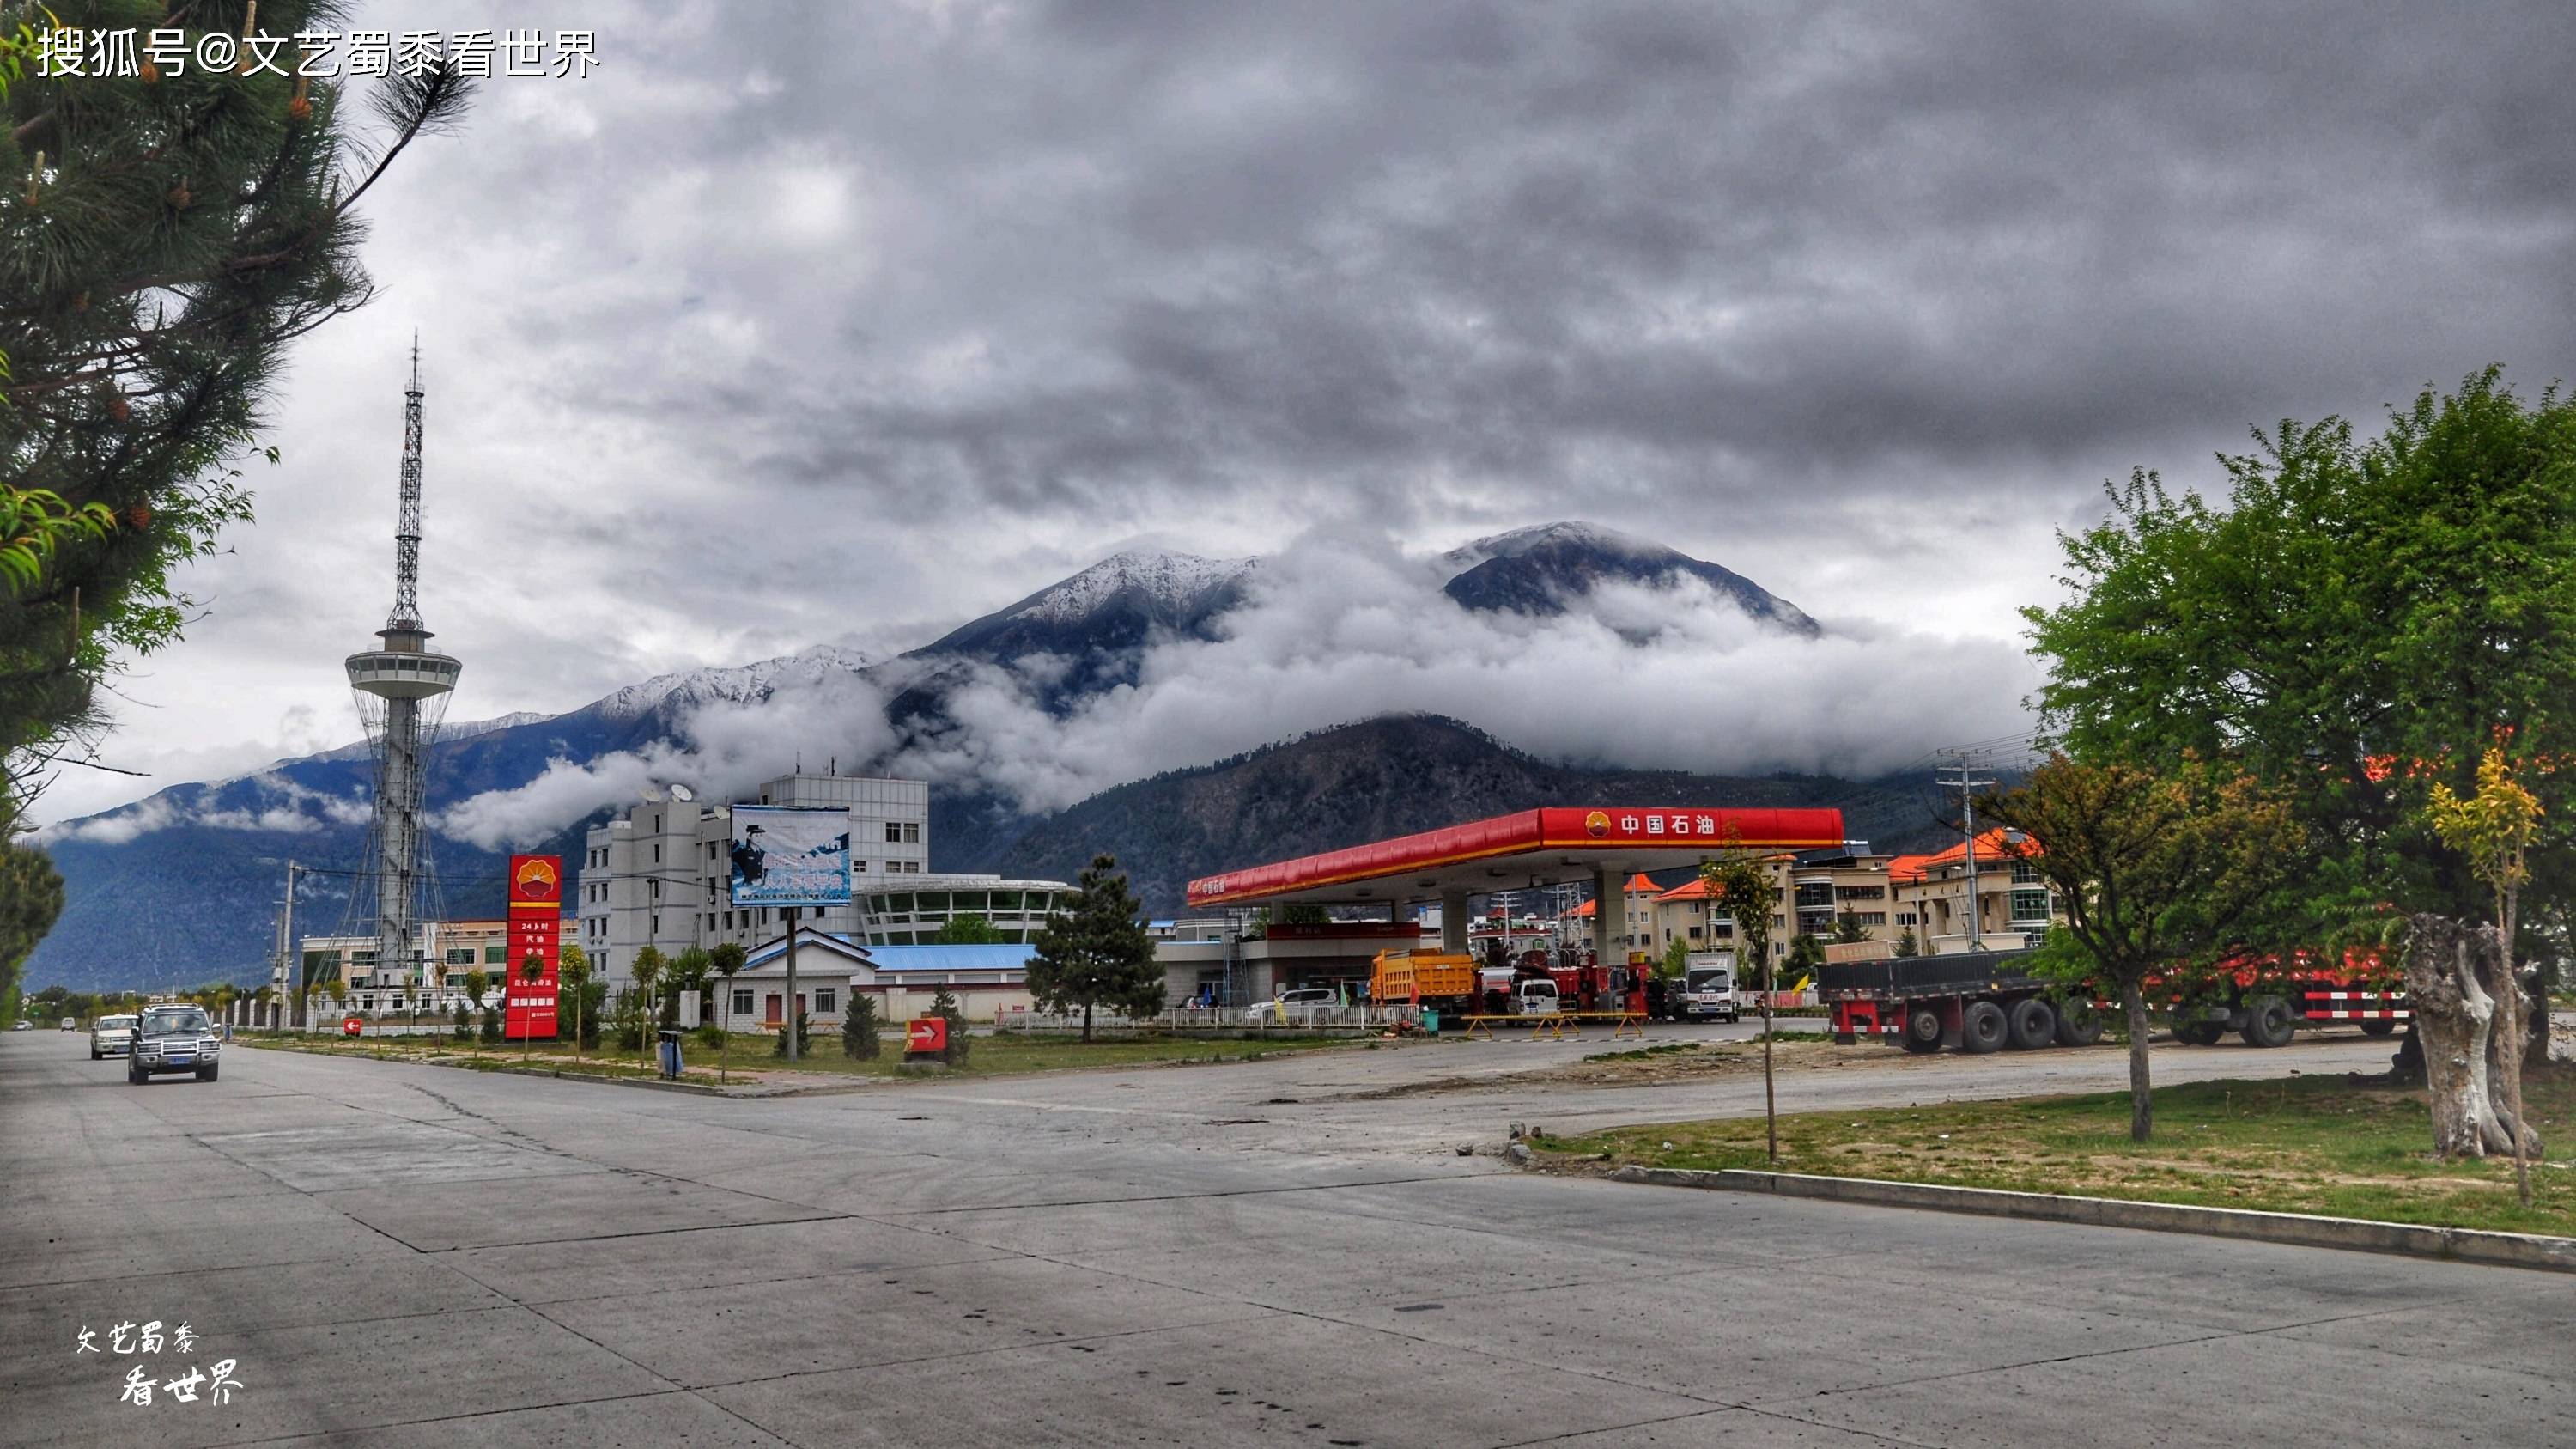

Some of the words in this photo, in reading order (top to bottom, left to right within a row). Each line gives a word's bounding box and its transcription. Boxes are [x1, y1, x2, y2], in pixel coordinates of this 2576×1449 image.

[1621, 815, 1715, 834] 中国石油
[526, 935, 544, 943] 汽油
